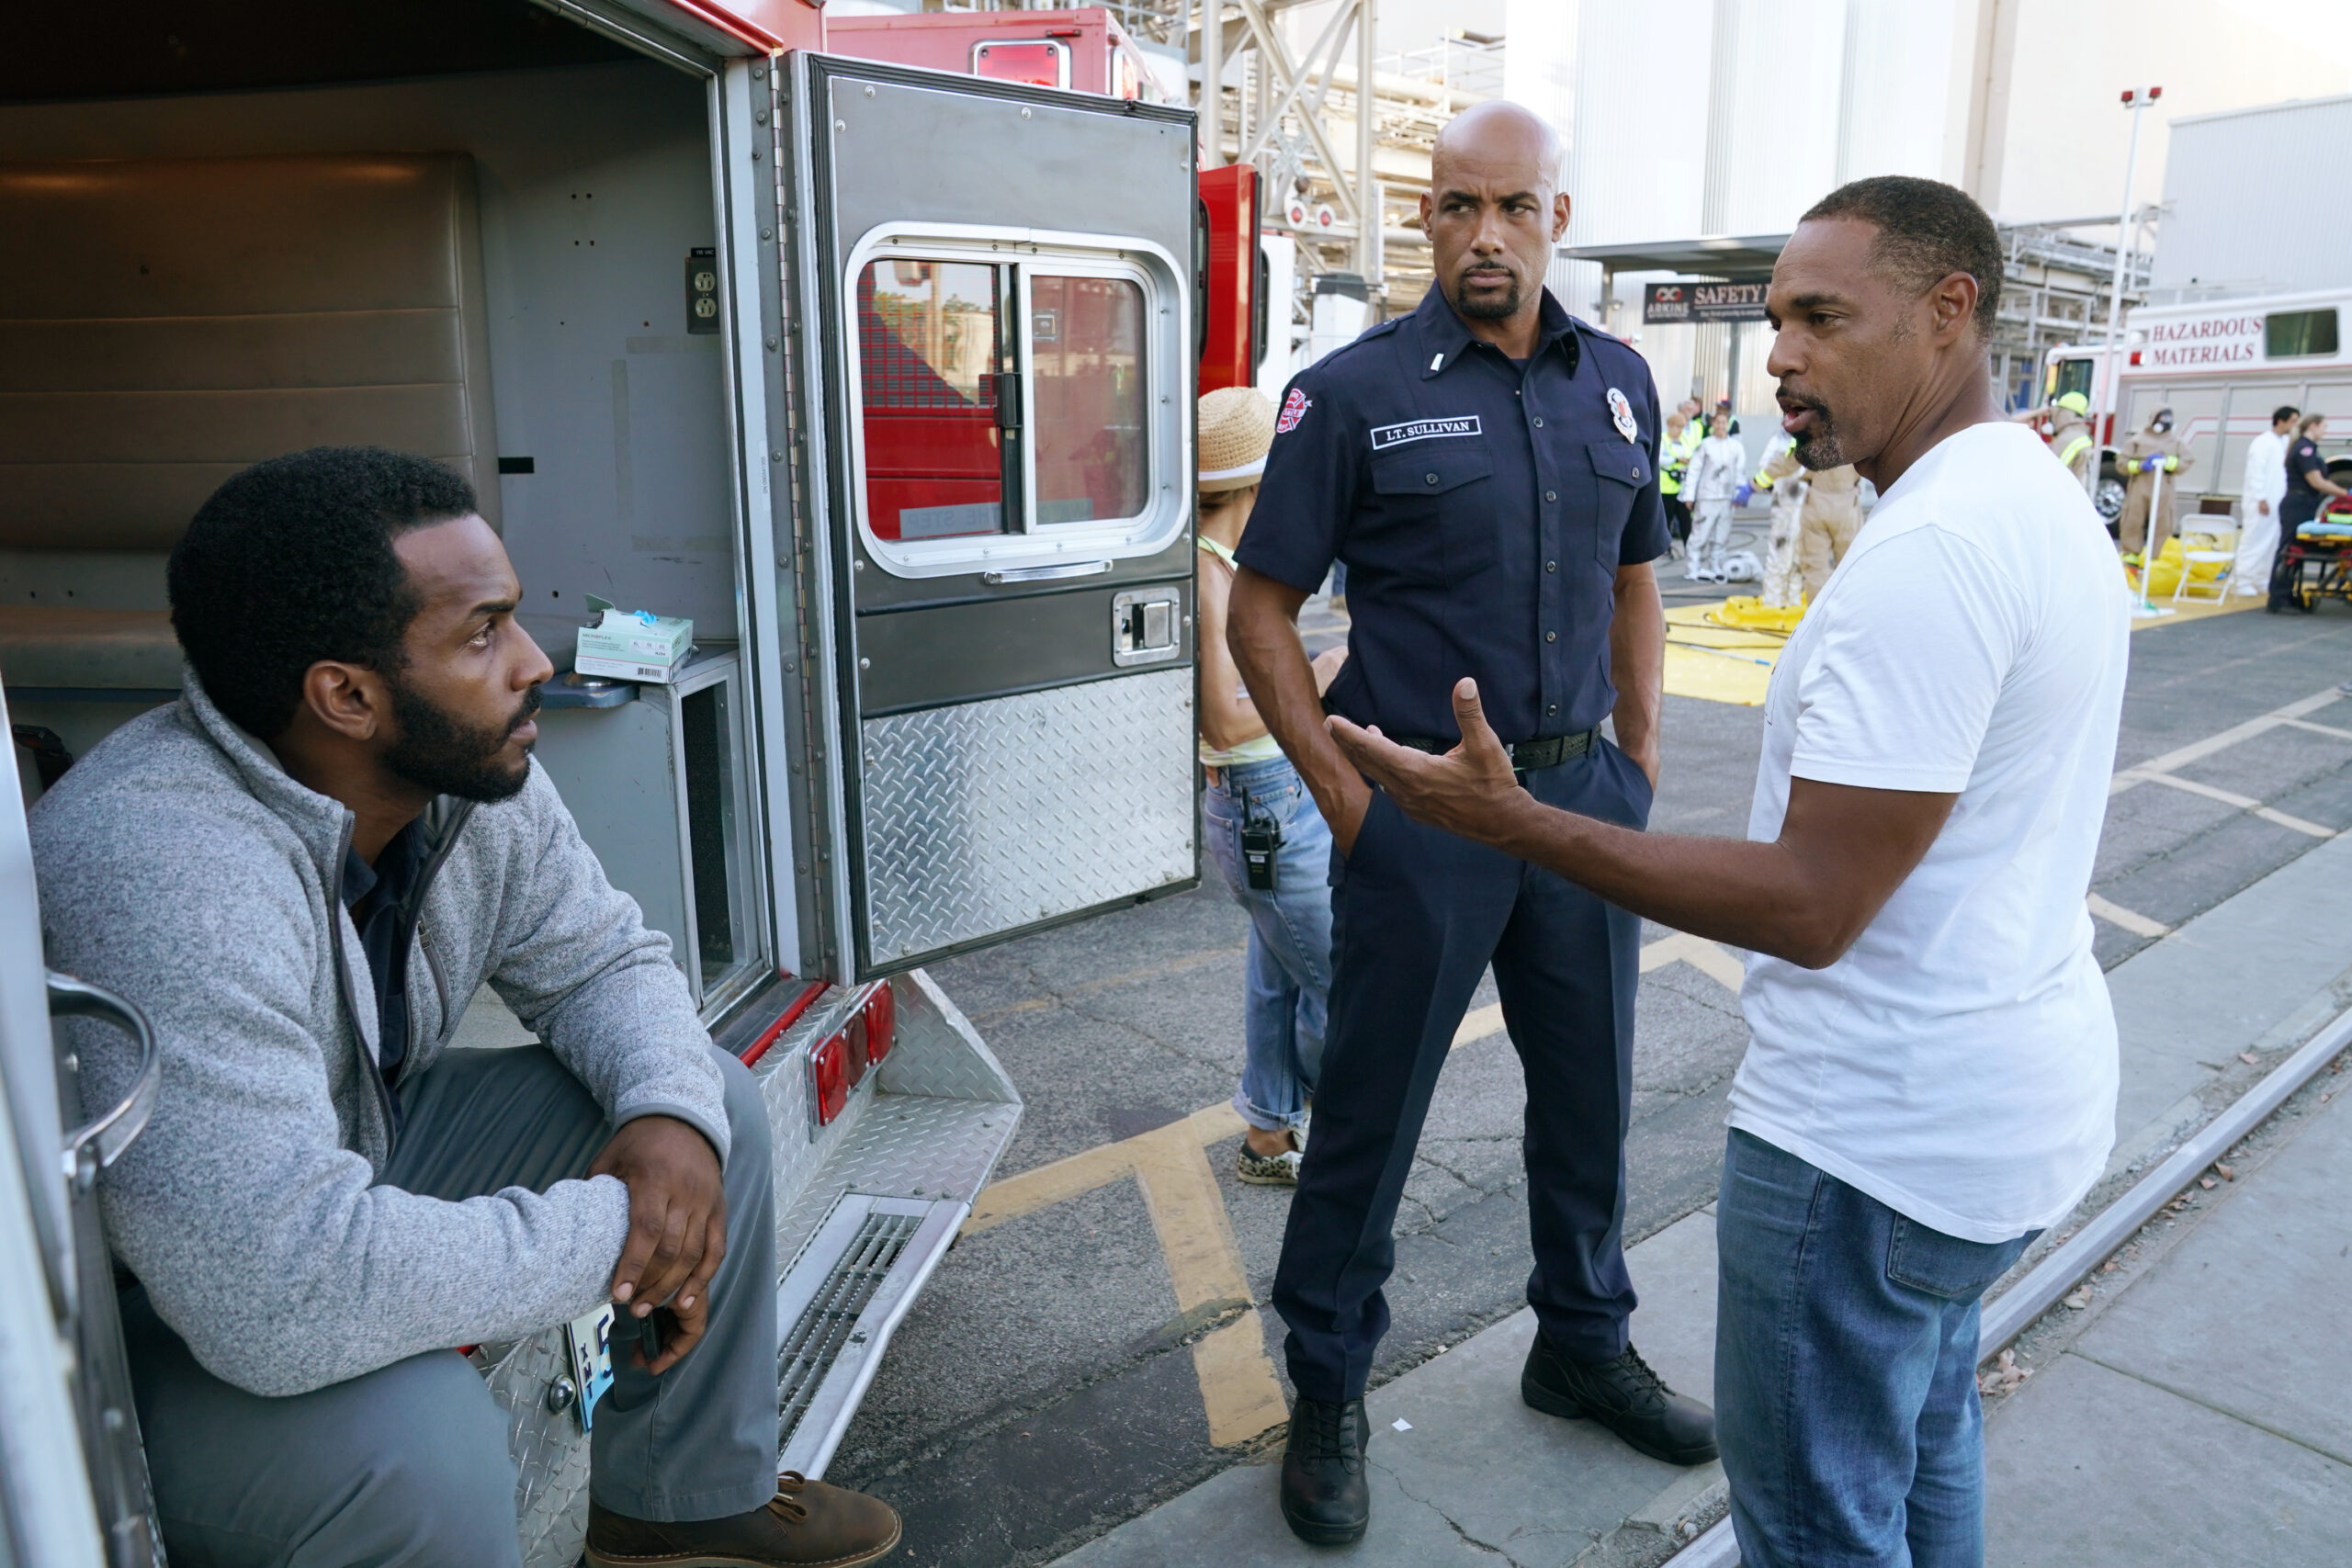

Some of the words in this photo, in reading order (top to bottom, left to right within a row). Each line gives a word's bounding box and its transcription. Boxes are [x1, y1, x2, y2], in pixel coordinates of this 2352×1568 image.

[1694, 284, 1762, 305] SAFETY
[2152, 316, 2265, 342] HAZARDOUS
[2153, 343, 2255, 366] MATERIALS
[1385, 429, 1407, 441] LT.
[1407, 422, 1470, 436] SULLIVAN
